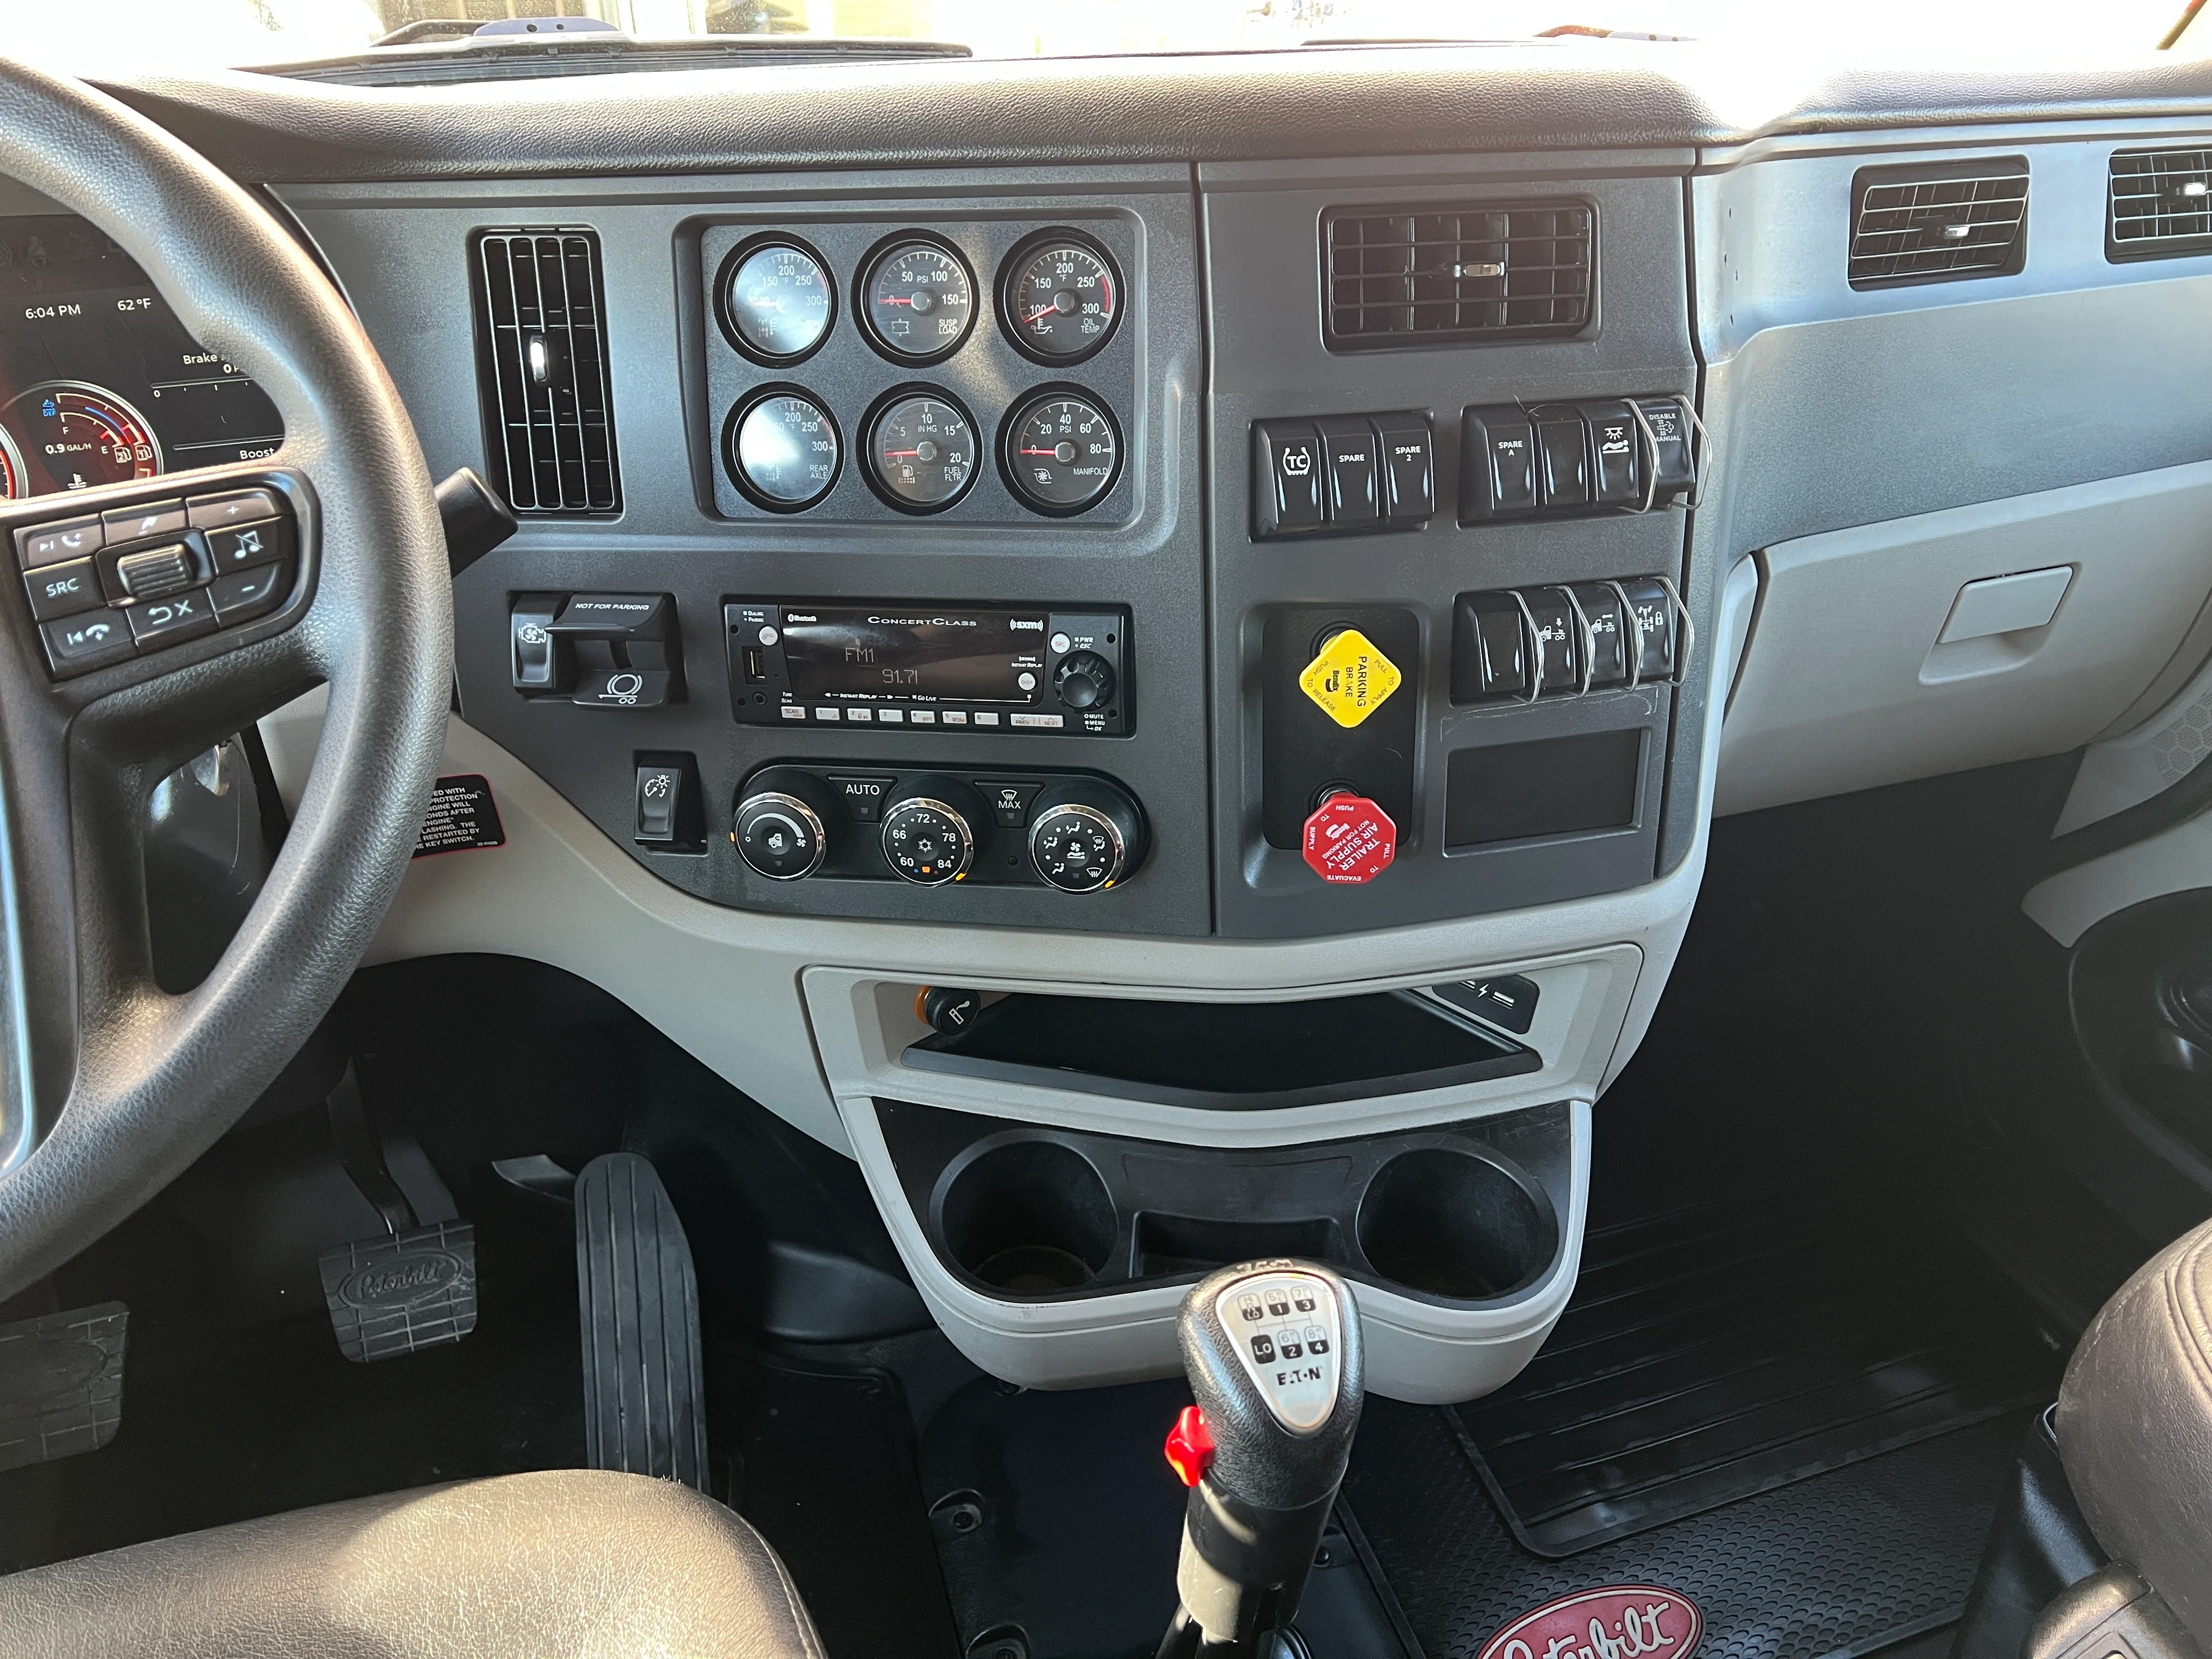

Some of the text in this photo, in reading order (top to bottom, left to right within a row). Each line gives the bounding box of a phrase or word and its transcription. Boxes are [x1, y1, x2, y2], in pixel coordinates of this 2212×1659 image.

[778, 266, 794, 275] 200
[1056, 263, 1074, 273] 200
[762, 276, 778, 286] 150
[795, 275, 812, 285] 250
[902, 271, 913, 281] 50
[931, 271, 947, 281] 100
[1034, 278, 1051, 289] 150
[1077, 276, 1094, 287] 250
[805, 295, 821, 306] 300
[942, 294, 958, 305] 150
[25, 304, 81, 319] 6:04 PM
[1082, 303, 1099, 314] 300
[183, 353, 218, 365] Brake
[223, 364, 232, 374] 0
[785, 413, 801, 422] 200
[922, 414, 932, 424] 10
[1060, 414, 1071, 424] 40
[63, 426, 69, 435] F
[802, 422, 817, 432] 250
[900, 427, 906, 437] 5
[944, 426, 956, 436] 15
[1040, 424, 1052, 434] 20
[1080, 424, 1091, 433] 60
[45, 443, 92, 455] 0.9 GAL/H
[101, 445, 108, 455] E
[812, 441, 828, 452] 300
[1090, 443, 1102, 454] 80
[1395, 446, 1421, 454] SPARE
[1498, 441, 1523, 449] SPARE
[239, 447, 275, 460] Boost
[950, 453, 961, 463] 20
[1339, 454, 1365, 462] SPARE
[897, 455, 902, 464] 0
[1287, 455, 1306, 469] TC
[46, 578, 79, 597] SRC
[845, 647, 874, 663] FM1
[1307, 660, 1336, 712] PUSH TO RELEASE
[1345, 667, 1353, 698] BRAKE
[1357, 656, 1367, 707] PARKING
[1370, 659, 1394, 706] PULL TO APPLY
[846, 784, 880, 795] AUTO
[430, 793, 478, 804] PROTECTION
[428, 803, 451, 811] NGINE
[998, 800, 1021, 809] MAX
[426, 810, 449, 819] ONDS
[916, 814, 930, 823] 72
[1320, 814, 1330, 822] TO
[422, 825, 458, 834] LASHING.
[423, 830, 469, 841] RESTARTED
[892, 830, 906, 840] 66
[942, 832, 956, 842] 78
[1322, 819, 1371, 859] NOT FOR PARKING
[442, 836, 475, 845] SWITCH.
[1326, 822, 1378, 870] AIR SUPPLY
[1339, 838, 1380, 871] TRAILER
[900, 857, 914, 867] 60
[938, 859, 952, 869] 84
[1268, 1293, 1276, 1302] 5
[1294, 1289, 1301, 1298] 7
[1277, 1305, 1283, 1314] 1
[1302, 1300, 1311, 1310] 3
[1281, 1334, 1289, 1343] 6
[1308, 1329, 1316, 1339] 8
[1255, 1343, 1272, 1356] LO
[1289, 1347, 1297, 1356] 2
[1315, 1342, 1323, 1352] 4
